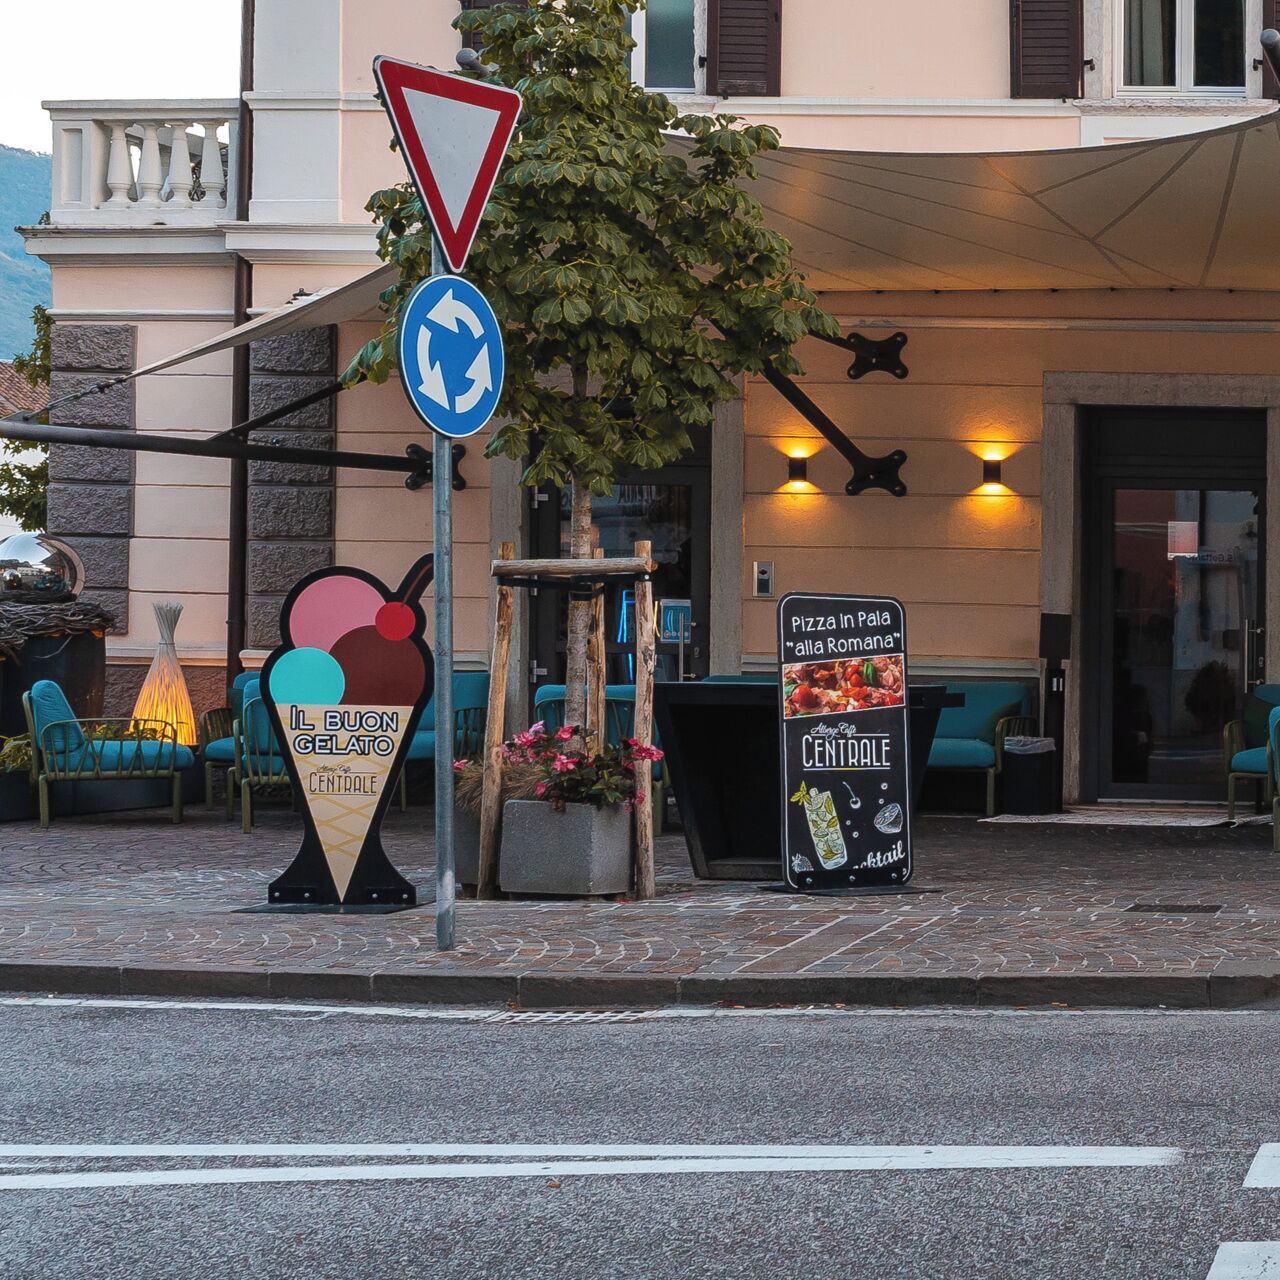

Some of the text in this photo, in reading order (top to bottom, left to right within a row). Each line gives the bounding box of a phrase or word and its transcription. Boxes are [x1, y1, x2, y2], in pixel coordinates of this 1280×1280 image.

[791, 616, 837, 632] Pizza
[858, 610, 891, 627] Pala
[290, 704, 399, 732] IL BUON
[292, 733, 395, 756] GELATO
[802, 735, 891, 767] CENTRALE
[309, 771, 378, 794] CENTRALE
